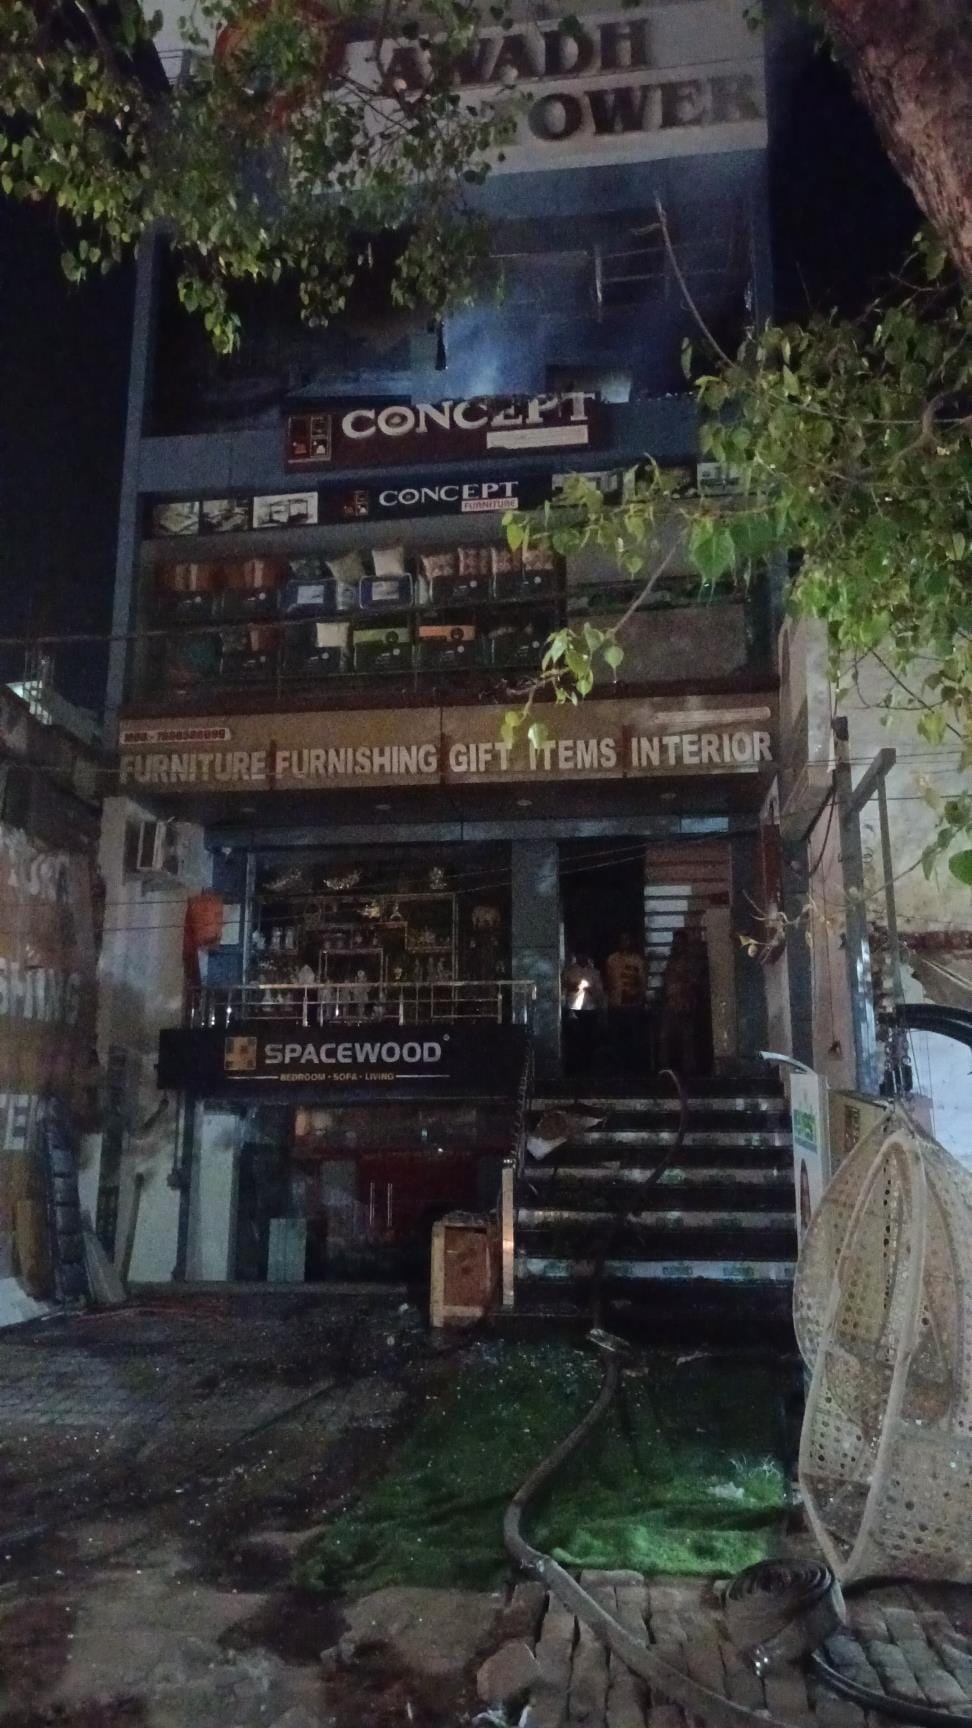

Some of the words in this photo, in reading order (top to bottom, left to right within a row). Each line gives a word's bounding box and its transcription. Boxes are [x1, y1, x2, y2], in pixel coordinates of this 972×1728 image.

[527, 74, 762, 141] OWER
[341, 391, 595, 439] CONCEPT
[378, 481, 519, 507] CONCEPT
[120, 750, 267, 784] FURNITURE
[275, 743, 438, 780] FURNISHING
[449, 740, 513, 773] GIFT
[528, 737, 617, 770] ITEMS
[631, 731, 773, 767] INTERIOR
[264, 1041, 442, 1064] SPACEWOOD
[280, 1073, 326, 1082] BEDROOM
[333, 1073, 358, 1082] SOFA
[365, 1072, 395, 1081] LIVING
